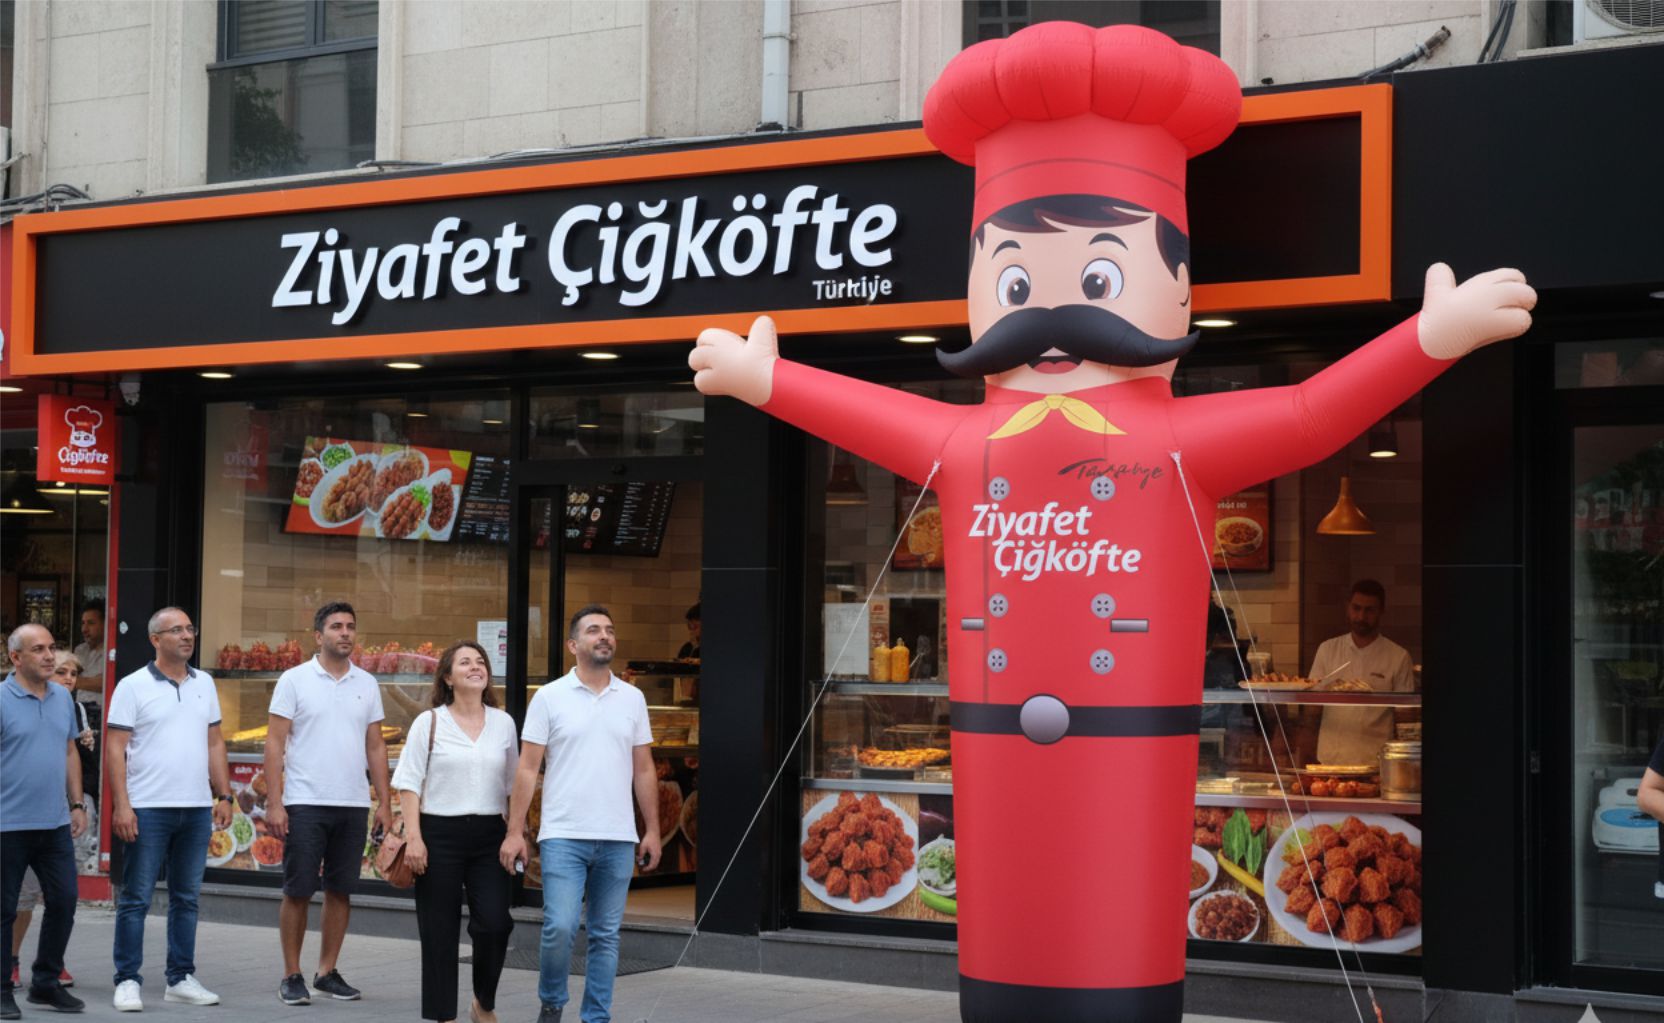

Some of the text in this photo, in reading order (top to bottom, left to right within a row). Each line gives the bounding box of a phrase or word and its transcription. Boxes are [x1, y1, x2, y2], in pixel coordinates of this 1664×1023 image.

[272, 184, 897, 326] Ziyafet Çiğköfte
[968, 502, 1092, 546] Ziyafet
[994, 539, 1141, 581] Çiğköfte
